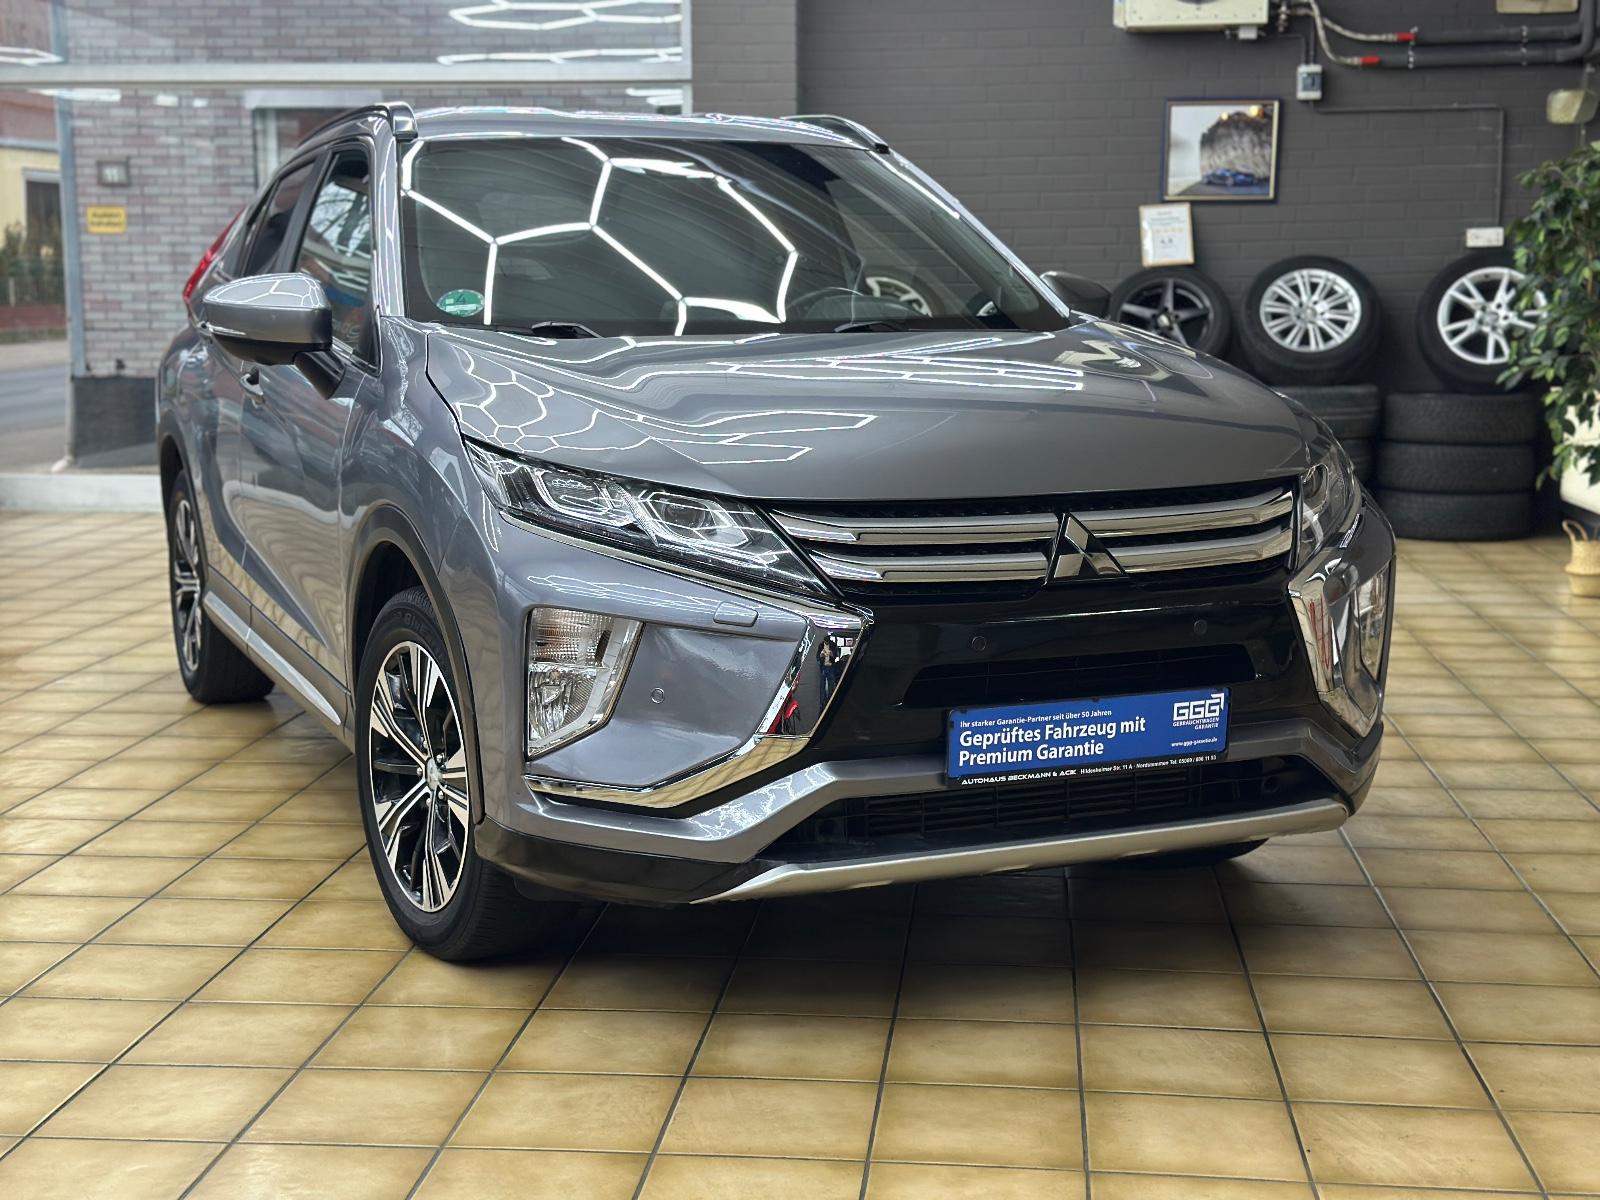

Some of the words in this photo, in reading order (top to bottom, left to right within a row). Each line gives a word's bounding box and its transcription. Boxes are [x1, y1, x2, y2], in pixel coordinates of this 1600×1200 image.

[971, 719, 996, 727] starker
[996, 715, 1052, 726] Garantie-Partner
[1065, 712, 1081, 720] über
[1173, 698, 1220, 721] GGG
[959, 726, 1041, 750] Geprüftes
[1045, 722, 1117, 739] Fahrzeug
[1120, 715, 1146, 734] mit
[959, 747, 1033, 767] Premium
[1036, 739, 1104, 760] Garantie
[961, 775, 1007, 785] AUTOHAUS
[1007, 771, 1051, 781] BECKMANN
